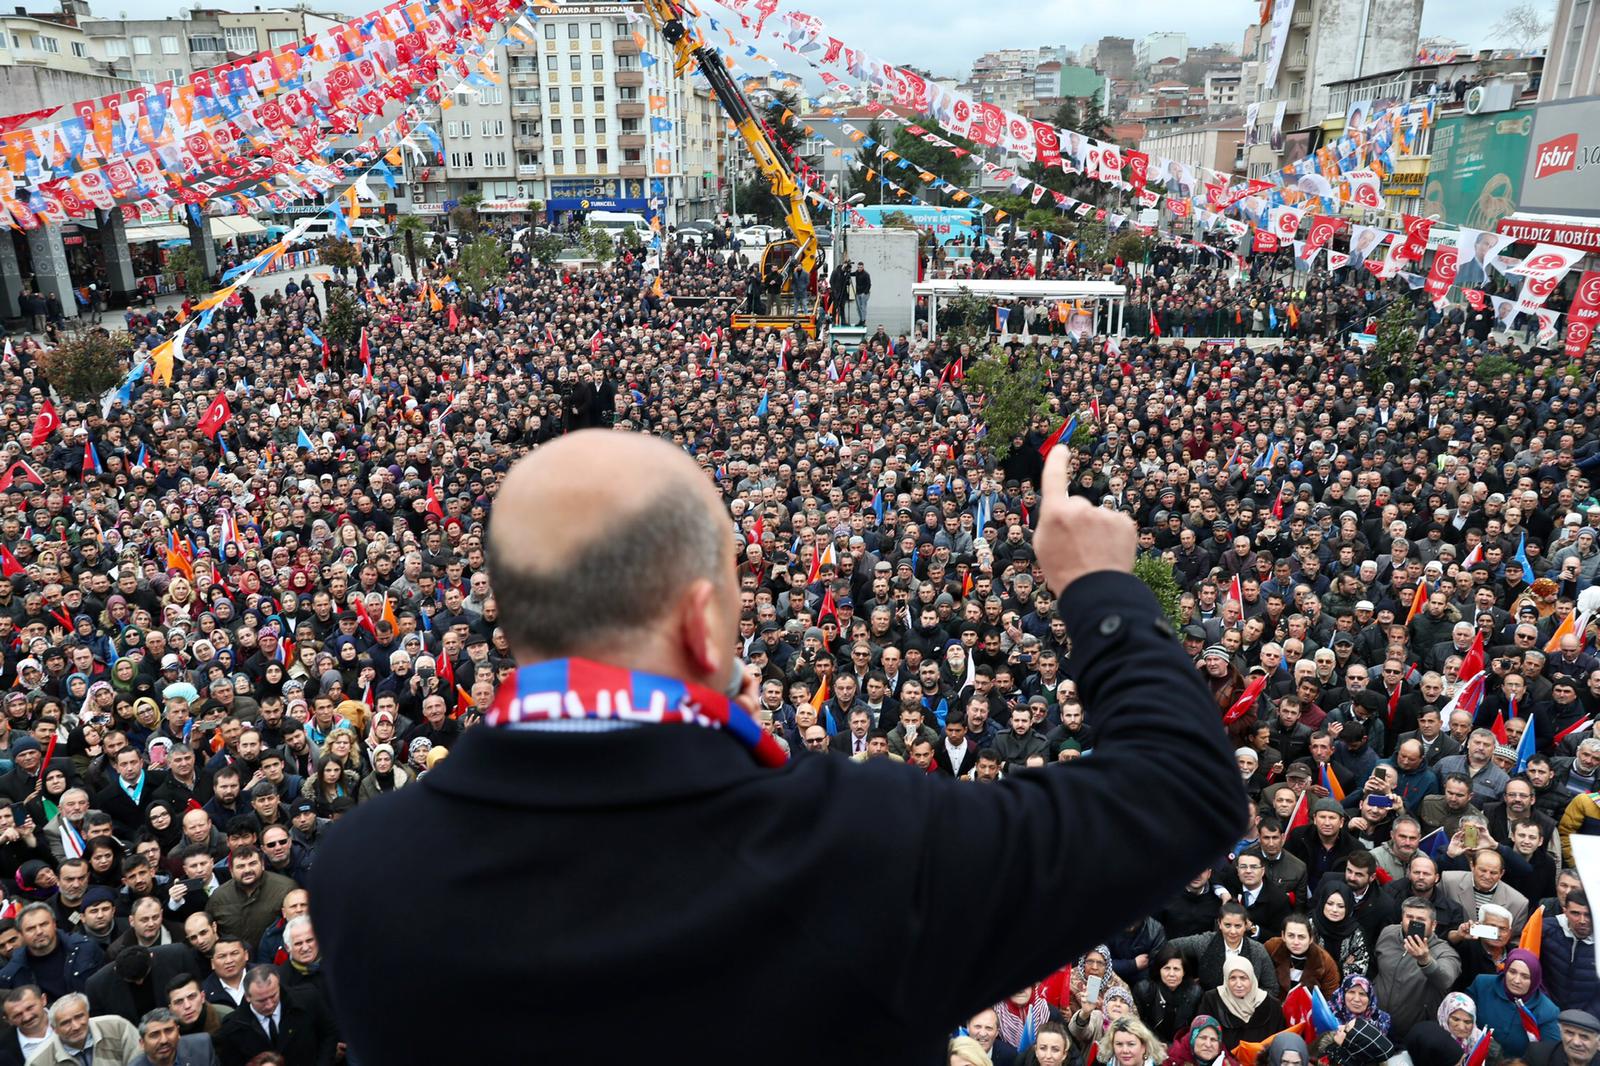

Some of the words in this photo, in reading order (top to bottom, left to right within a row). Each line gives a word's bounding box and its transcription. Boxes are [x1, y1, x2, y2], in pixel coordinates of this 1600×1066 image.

[1012, 143, 1028, 151] MHP
[1042, 149, 1058, 157] MHP
[1512, 225, 1552, 242] YILDIZ
